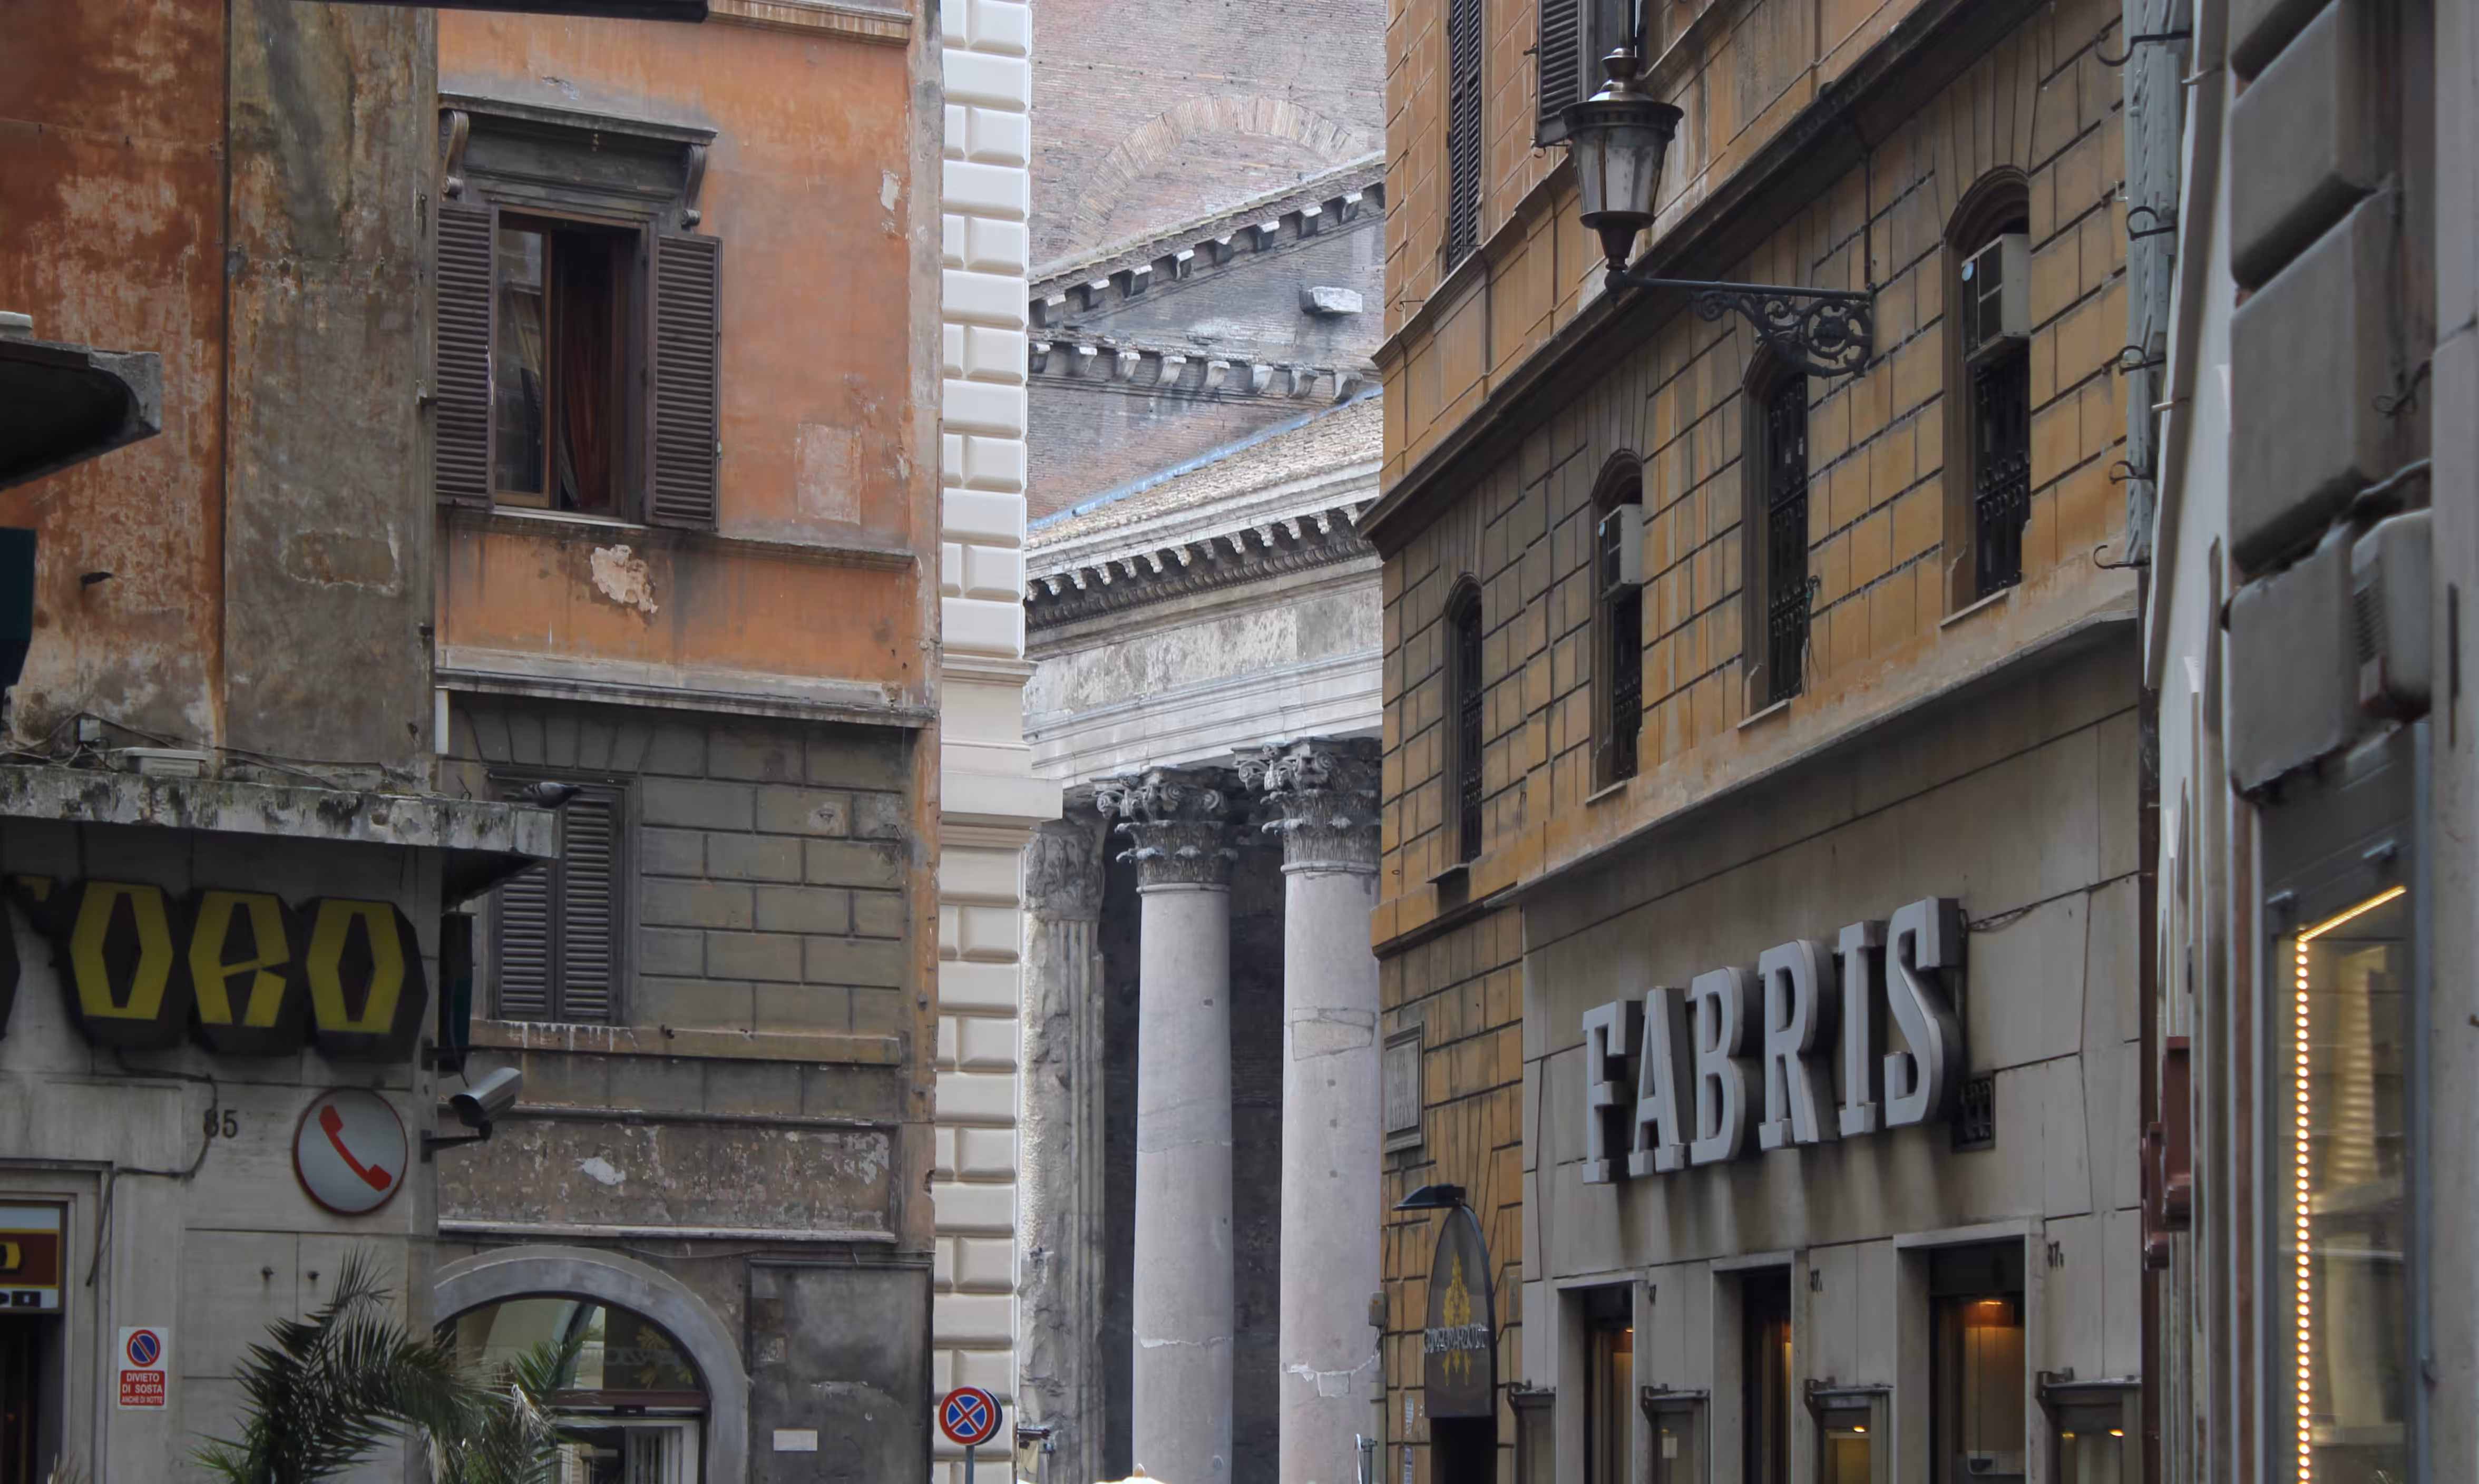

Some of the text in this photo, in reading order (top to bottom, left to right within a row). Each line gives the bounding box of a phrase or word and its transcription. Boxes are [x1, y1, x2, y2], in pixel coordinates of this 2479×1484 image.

[0, 874, 405, 1034] 'ORO
[1582, 895, 1961, 1185] FABRIS
[203, 1109, 238, 1139] 85
[122, 1384, 162, 1393] DI SOSTA
[126, 1373, 159, 1382] DIVIETO
